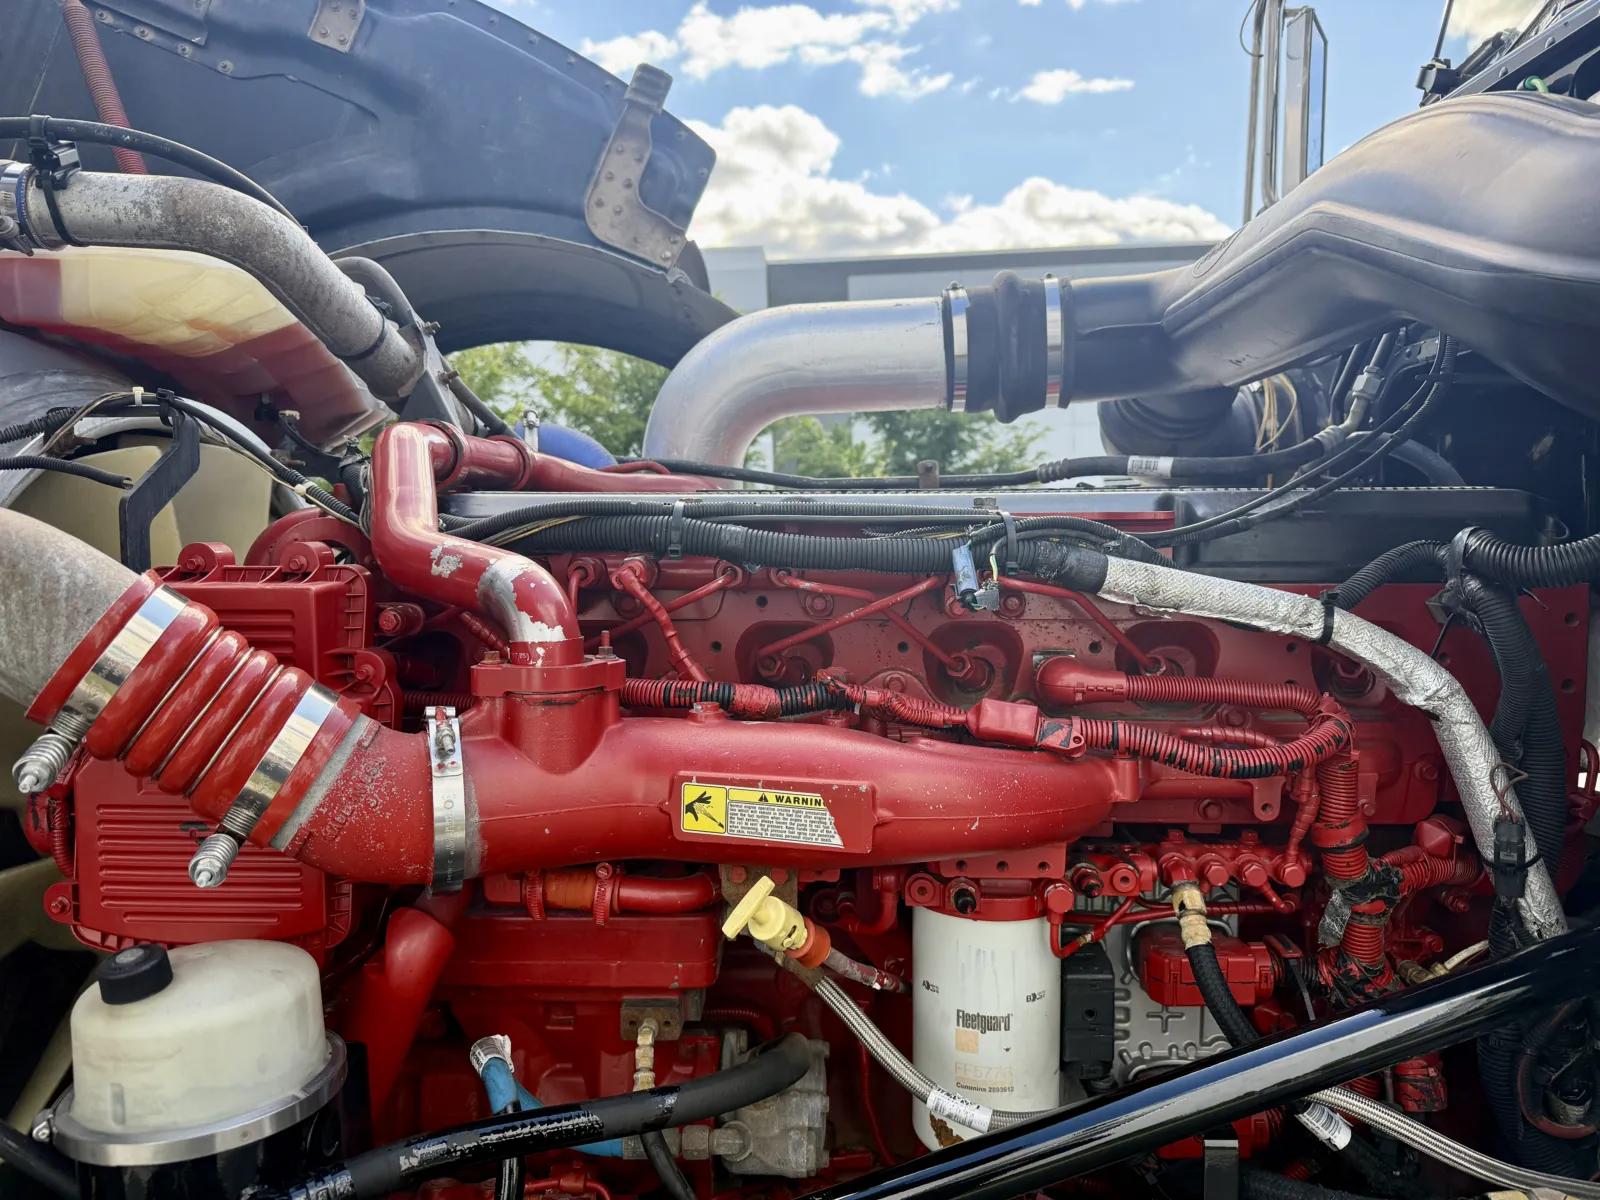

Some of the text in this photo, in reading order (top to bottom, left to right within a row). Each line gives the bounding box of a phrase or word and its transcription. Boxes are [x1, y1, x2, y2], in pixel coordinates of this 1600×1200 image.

[775, 795, 825, 807] WARNIN
[956, 1009, 1011, 1034] Fleetguard
[956, 1081, 987, 1092] Cummins
